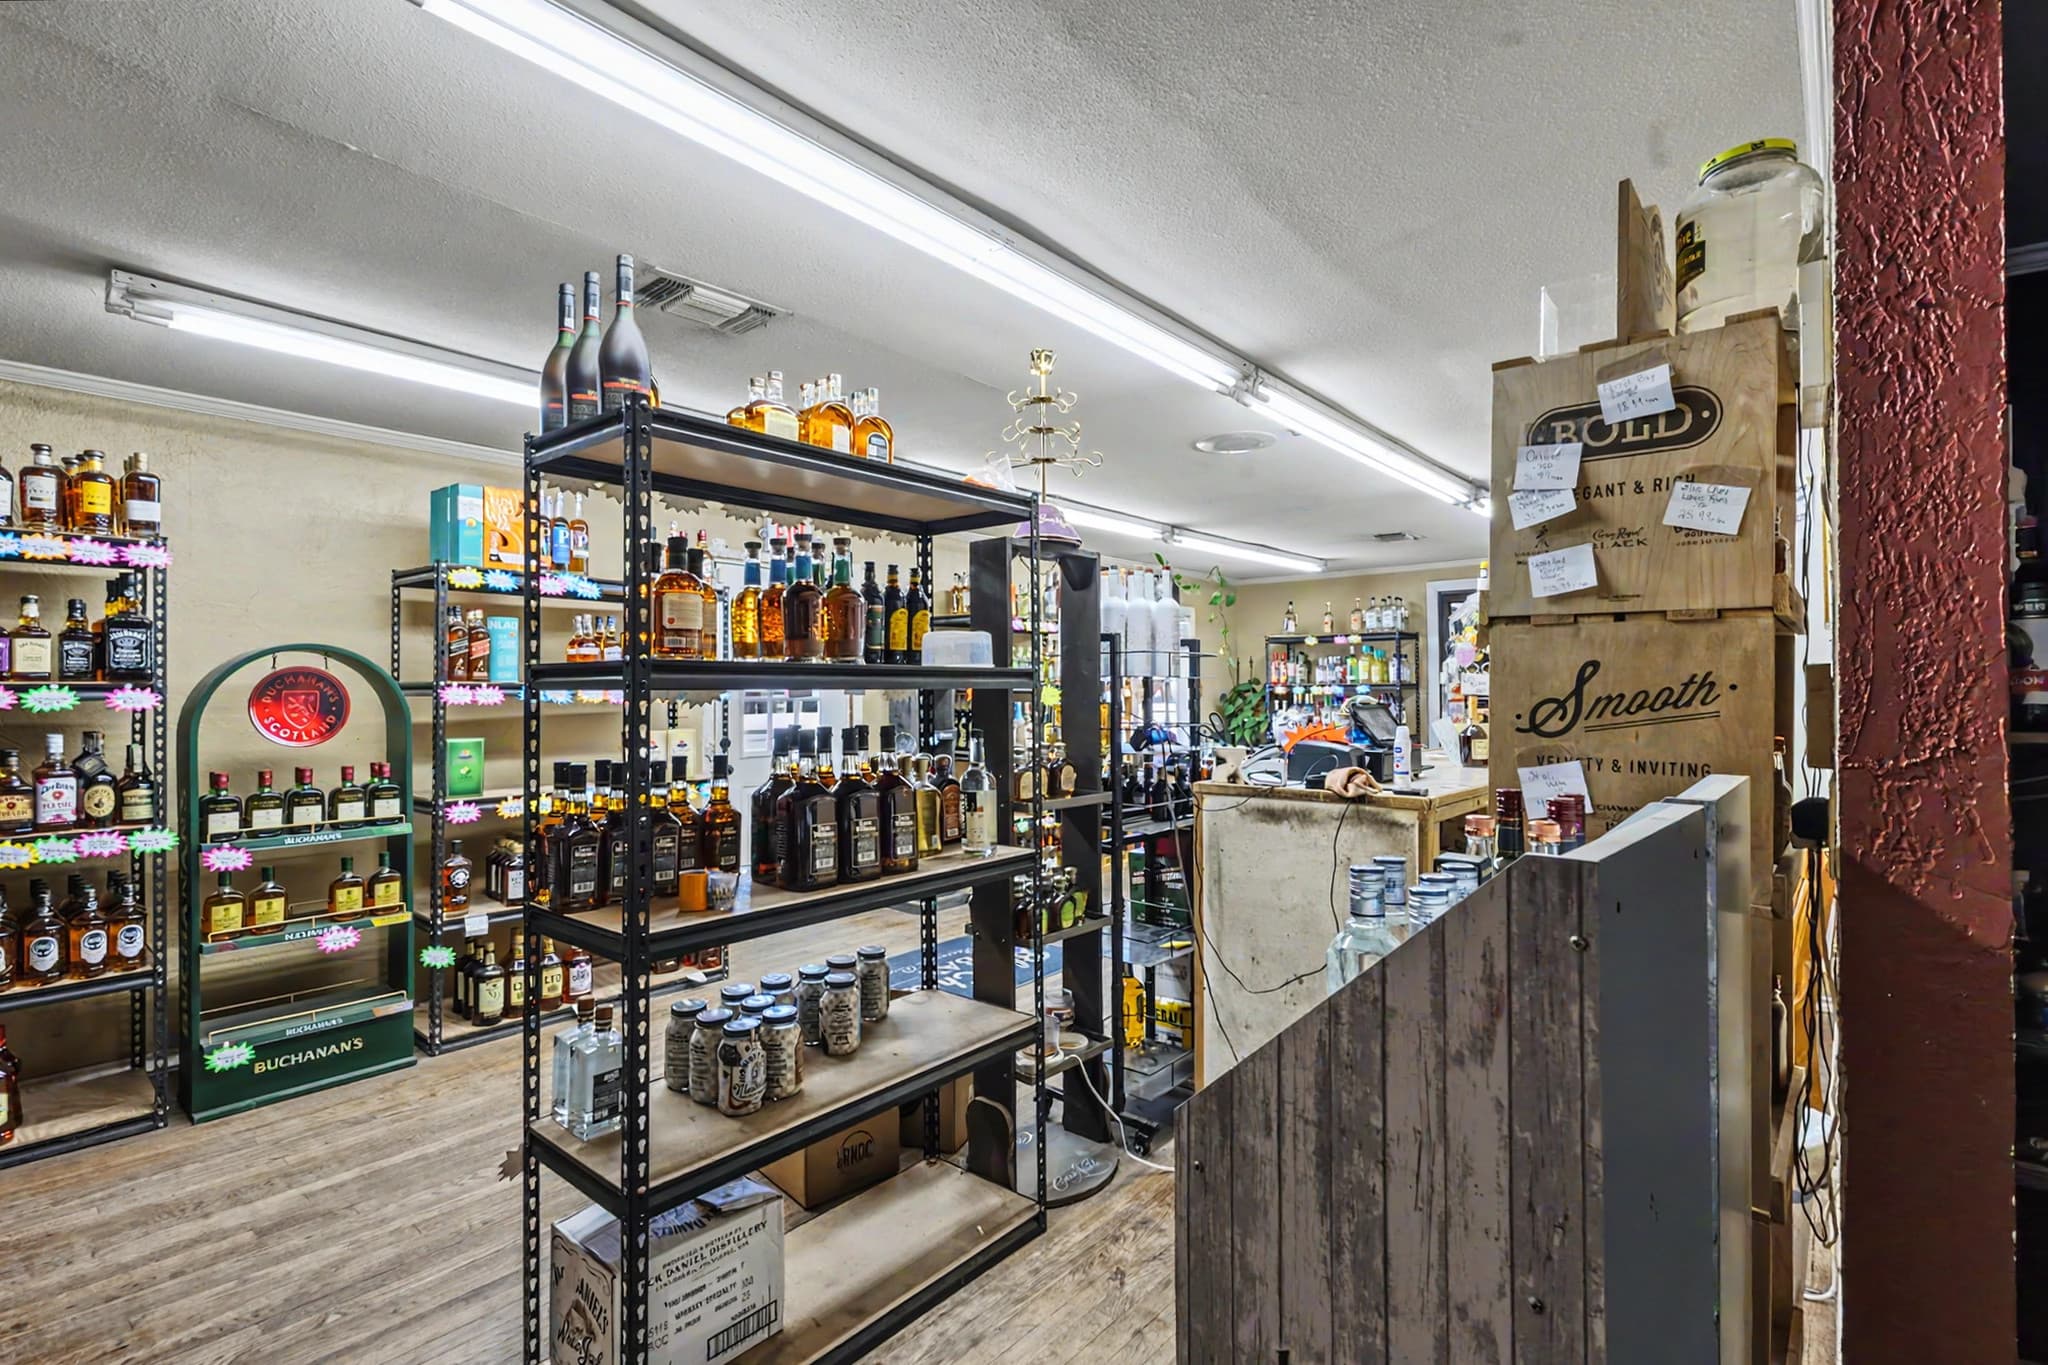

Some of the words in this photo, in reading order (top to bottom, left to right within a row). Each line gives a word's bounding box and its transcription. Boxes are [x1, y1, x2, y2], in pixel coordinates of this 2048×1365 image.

[1551, 402, 1694, 448] BOLD
[1633, 479, 1645, 494] &
[1515, 659, 1721, 738] Smooth
[1612, 759, 1622, 773] &
[1629, 762, 1712, 778] INVITING
[253, 1036, 364, 1075] BUCHANAN'S
[666, 1253, 707, 1278] DANIEL
[709, 1219, 768, 1257] DISTILLERY
